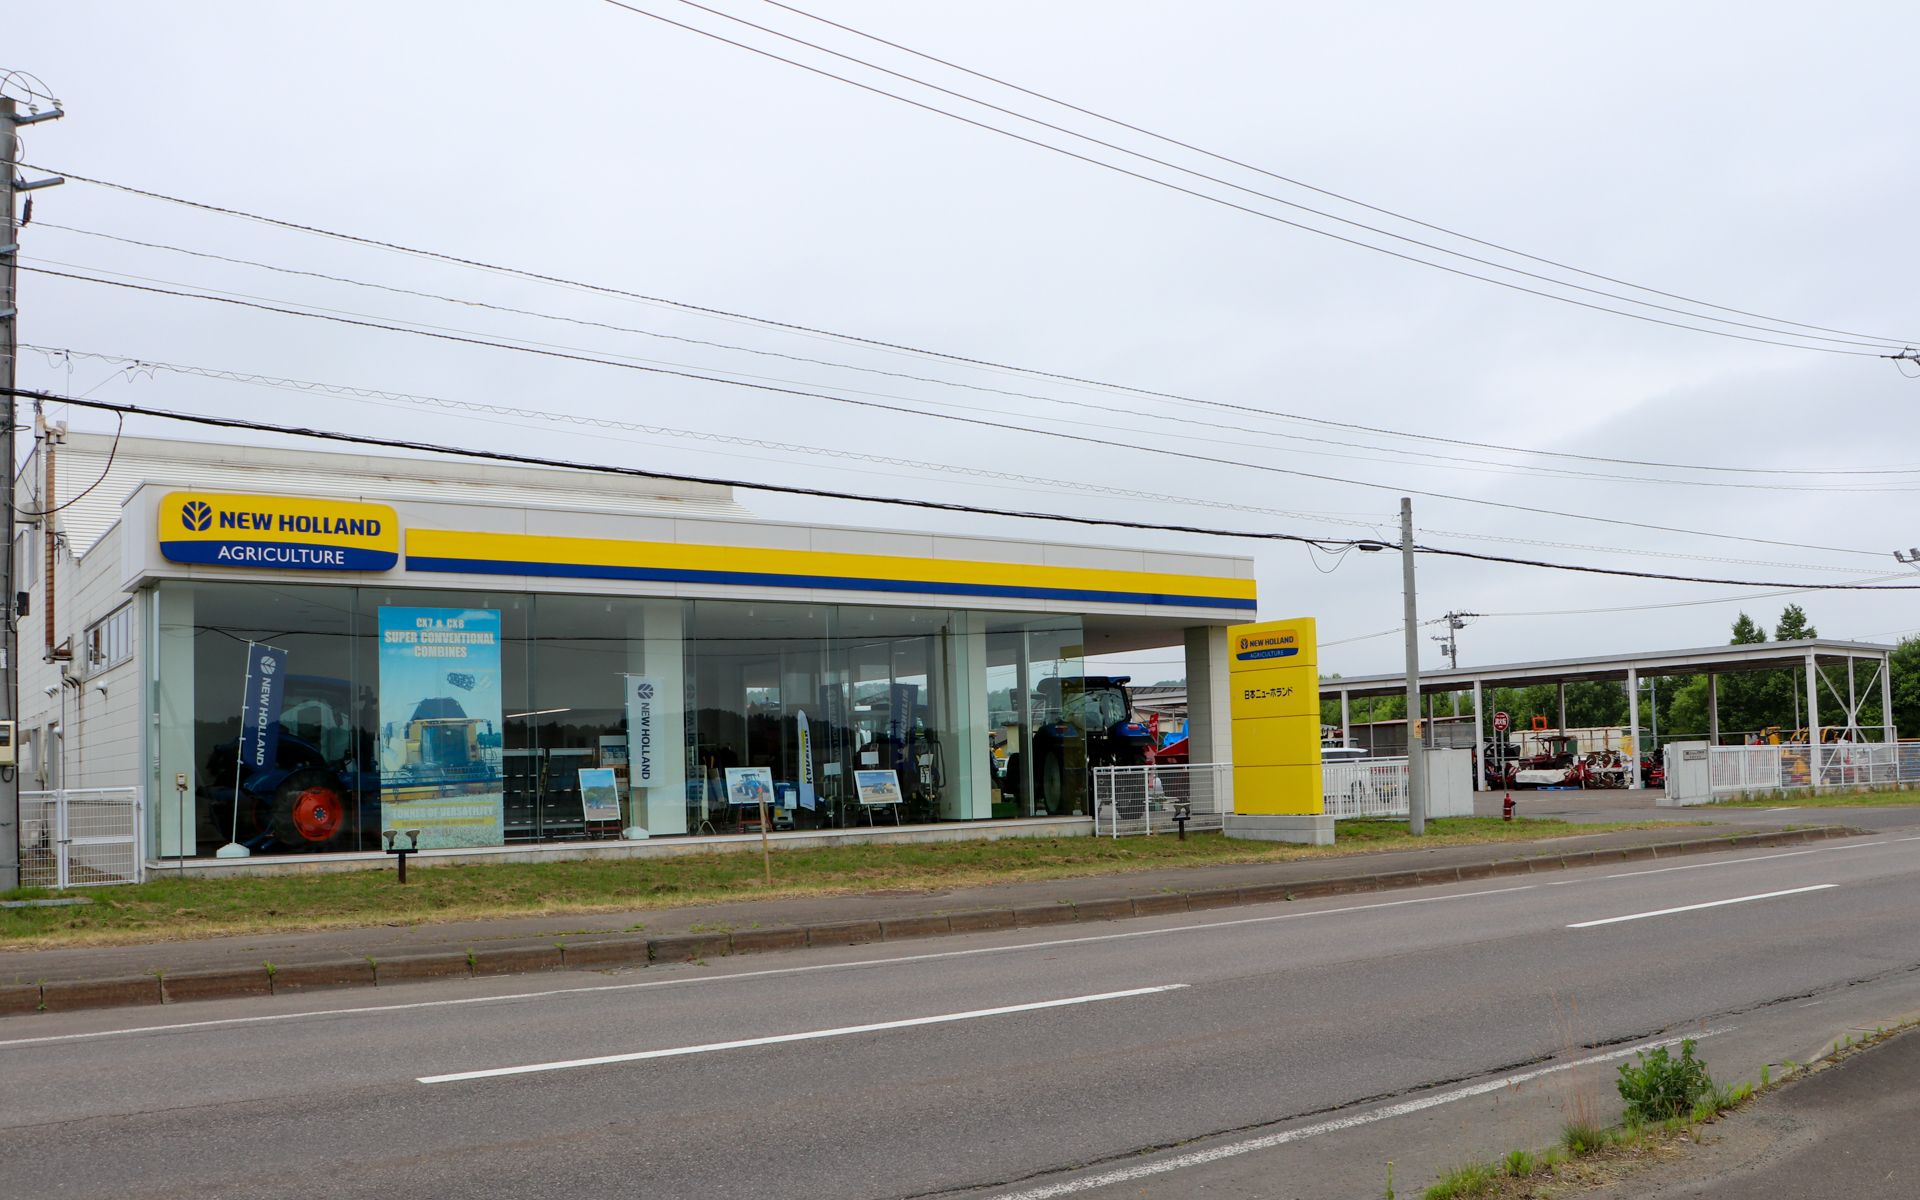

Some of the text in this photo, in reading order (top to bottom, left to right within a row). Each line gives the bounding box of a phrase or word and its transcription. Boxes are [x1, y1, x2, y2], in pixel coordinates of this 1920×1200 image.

[219, 511, 381, 537] NEW HOLLAND
[217, 545, 345, 565] AGRICULTURE
[416, 617, 465, 629] CX7 & CX8
[384, 630, 496, 645] SUPER CONVENTIONAL
[1250, 636, 1294, 647] NEW HOLLAND
[414, 645, 468, 658] COMBINES
[1250, 650, 1284, 658] AGRICULTURE
[1245, 687, 1293, 699] 日本ニューホランド
[256, 677, 271, 766] NEW HOLLAND
[900, 689, 909, 744] MICHELIN
[641, 702, 651, 780] NEW HOLLAND
[392, 805, 494, 819] TONNES OF VERSATILITY
